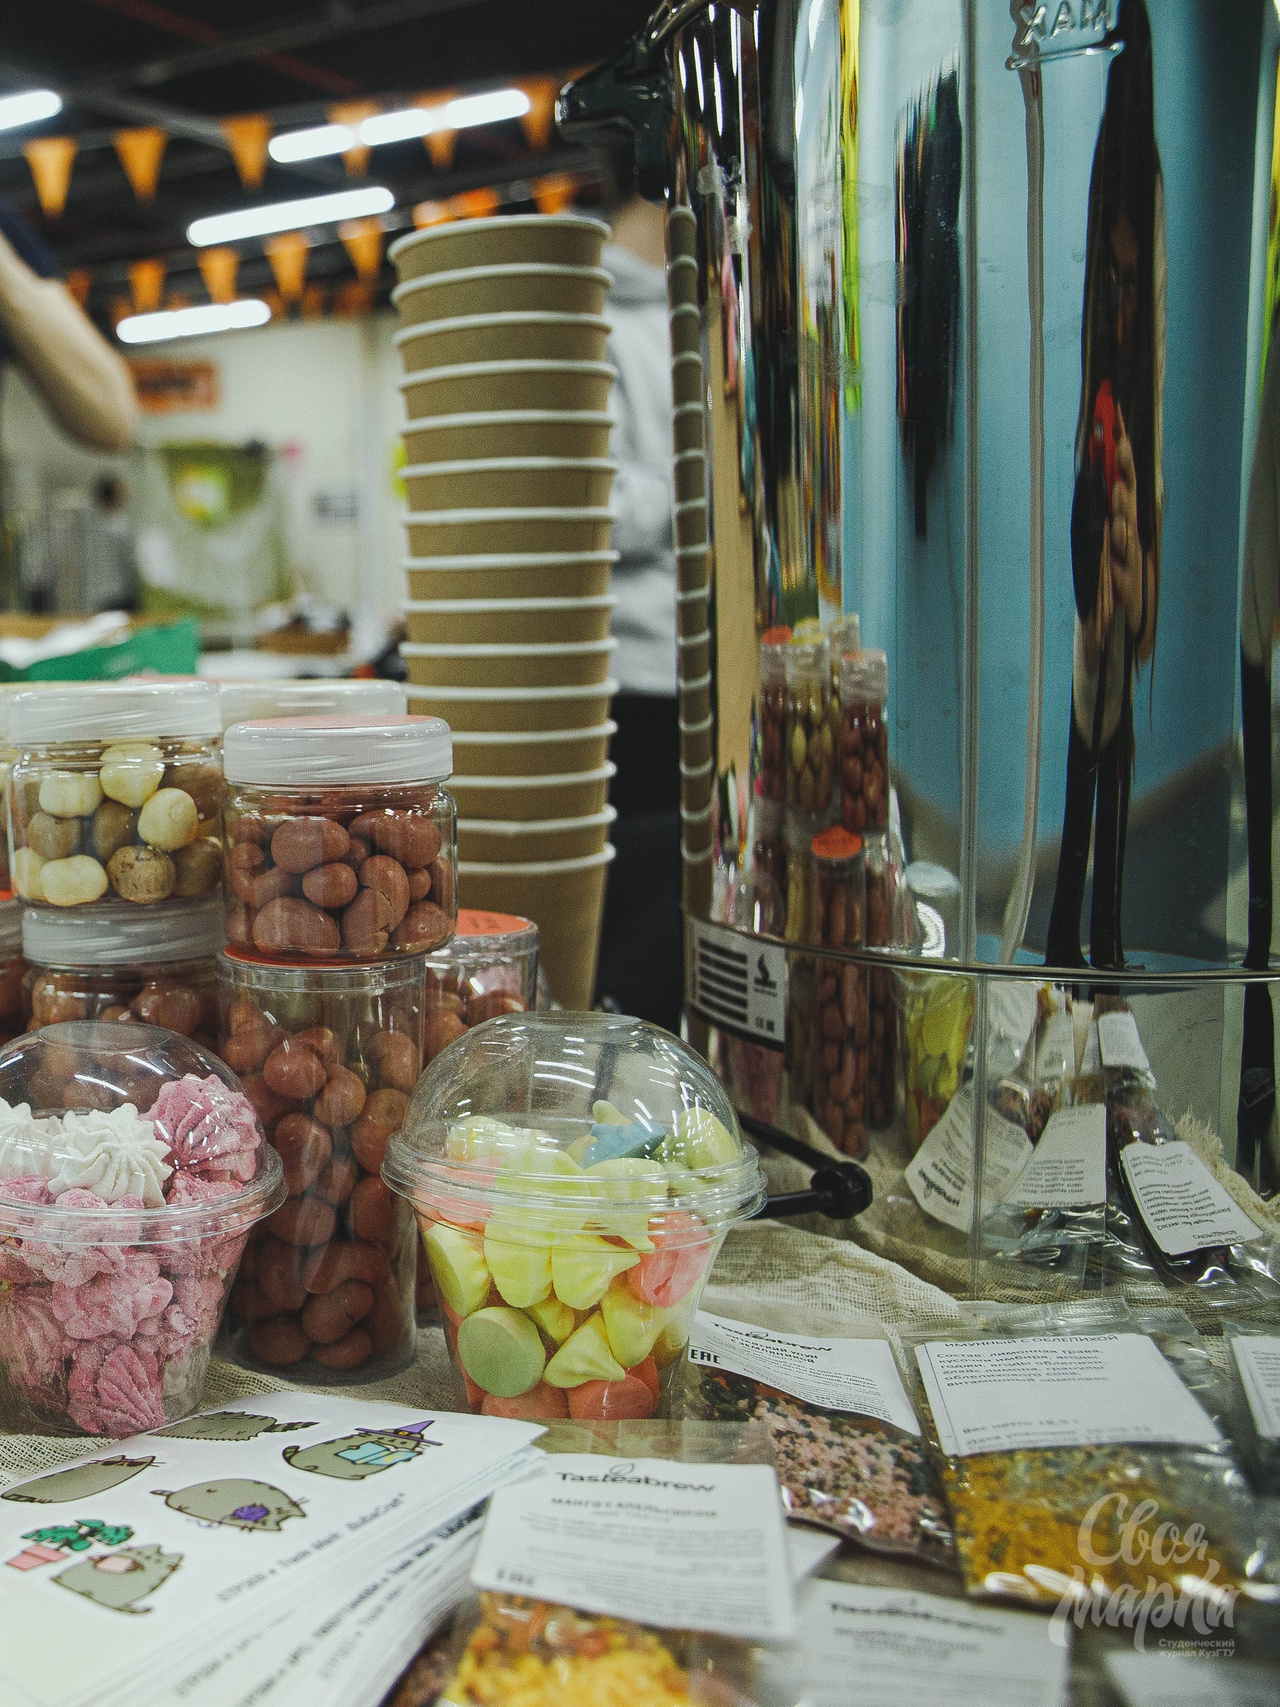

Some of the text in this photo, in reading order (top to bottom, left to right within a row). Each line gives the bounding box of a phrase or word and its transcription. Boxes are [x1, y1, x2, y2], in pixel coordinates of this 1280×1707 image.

[944, 1339, 1017, 1348] ИМУННЫЙ
[1032, 1334, 1118, 1343] ОБЛЕПИХОЙ
[989, 1349, 1058, 1358] лимонная
[556, 1470, 716, 1493] Tasteabrew
